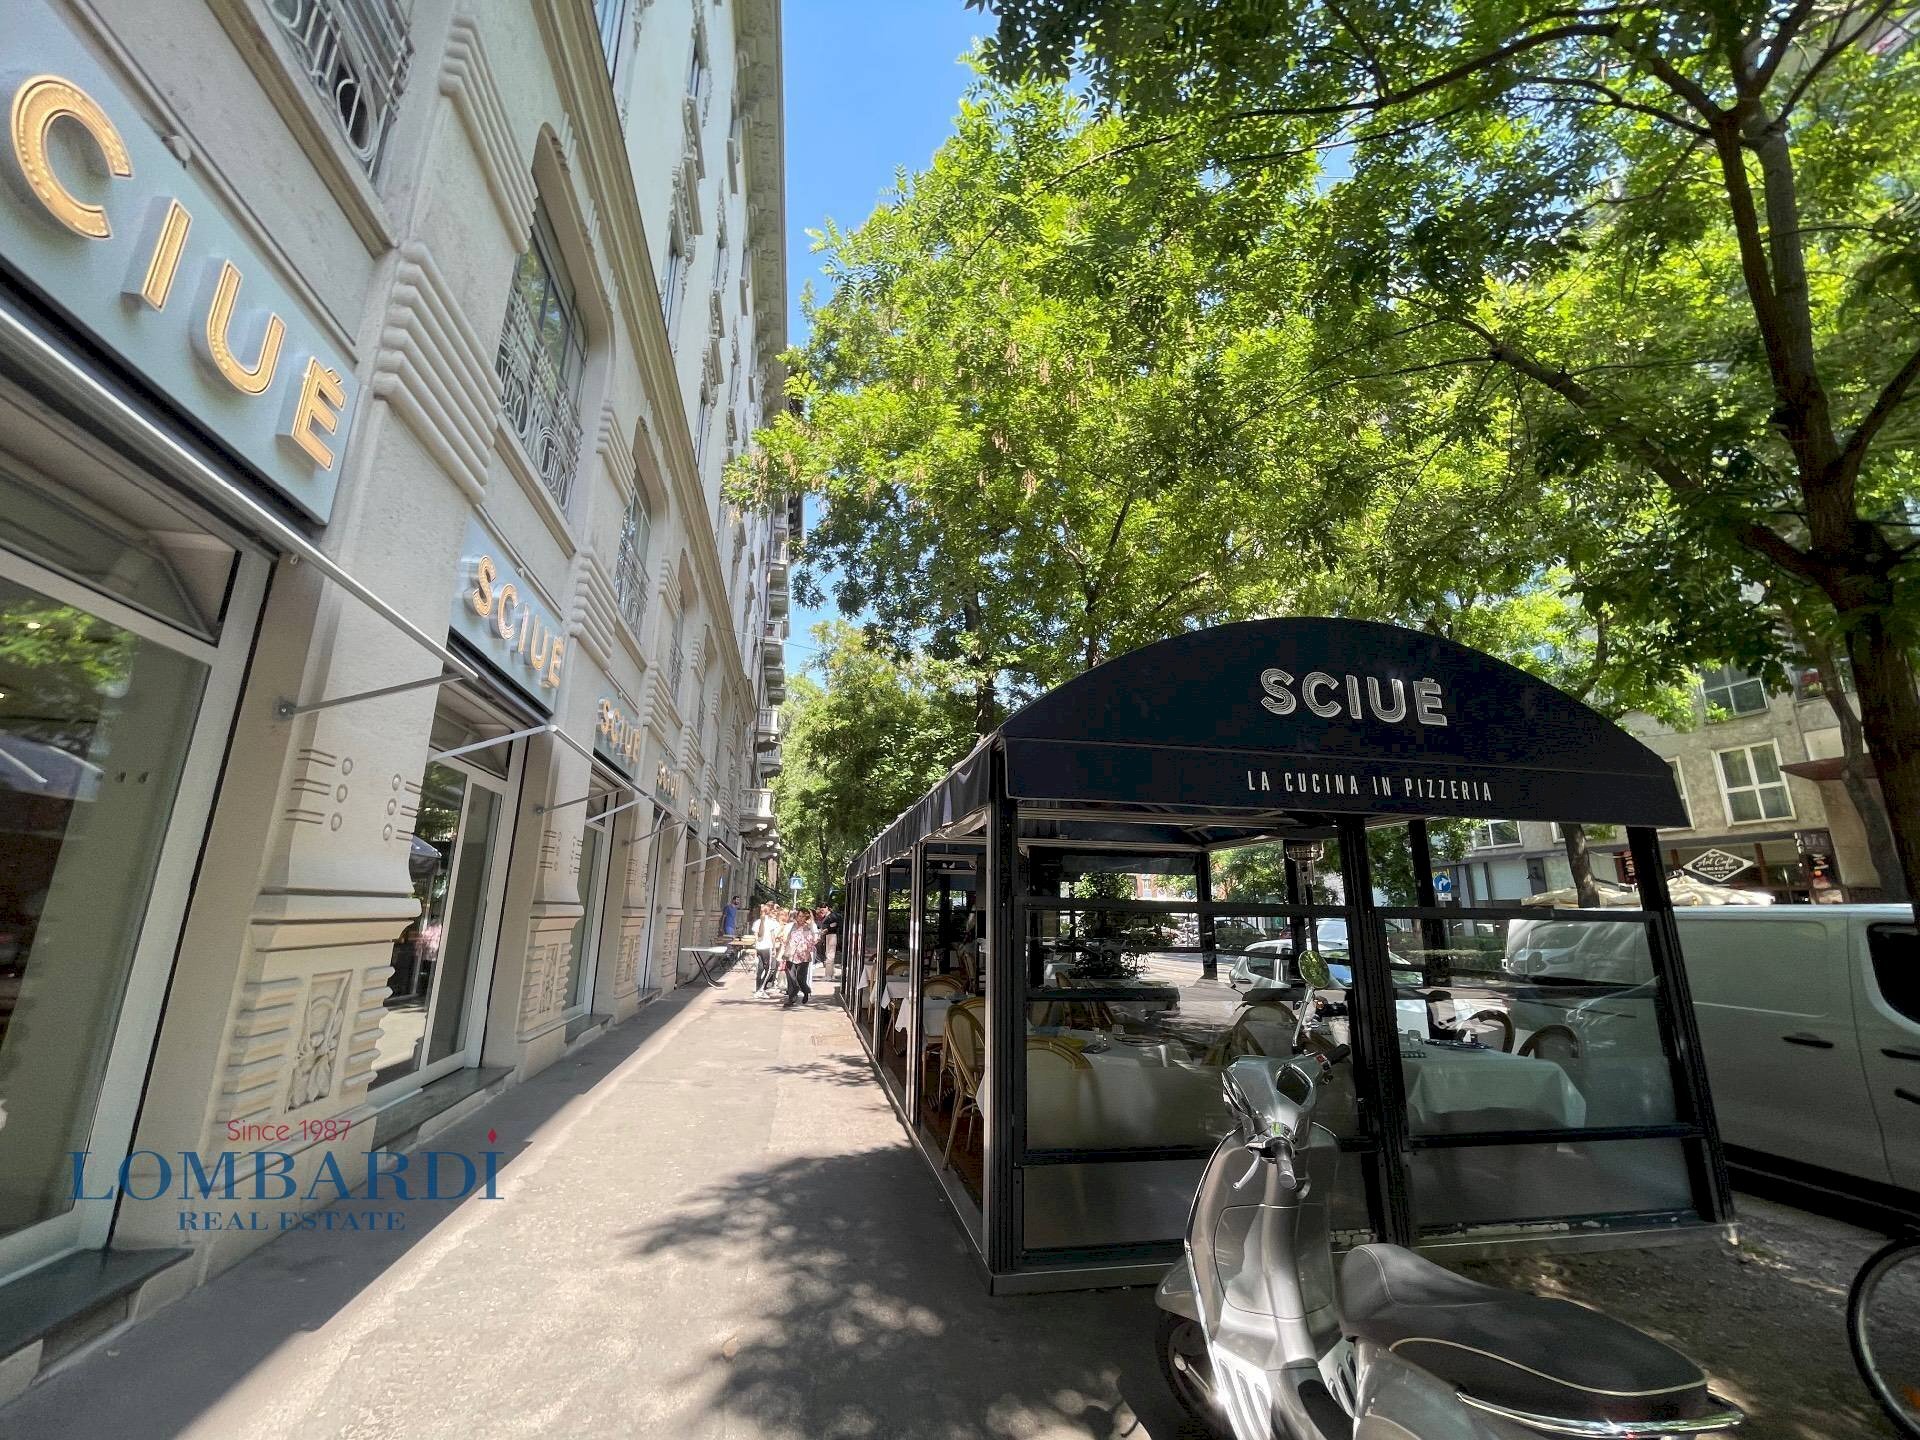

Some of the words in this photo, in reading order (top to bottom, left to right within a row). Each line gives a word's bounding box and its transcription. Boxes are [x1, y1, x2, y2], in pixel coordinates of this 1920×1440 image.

[1260, 668, 1448, 726] SCIUÉ
[1247, 770, 1270, 791] LA
[1284, 772, 1359, 795] CUCINA
[1372, 776, 1392, 796] IN
[1404, 778, 1492, 801] PIZZERIA
